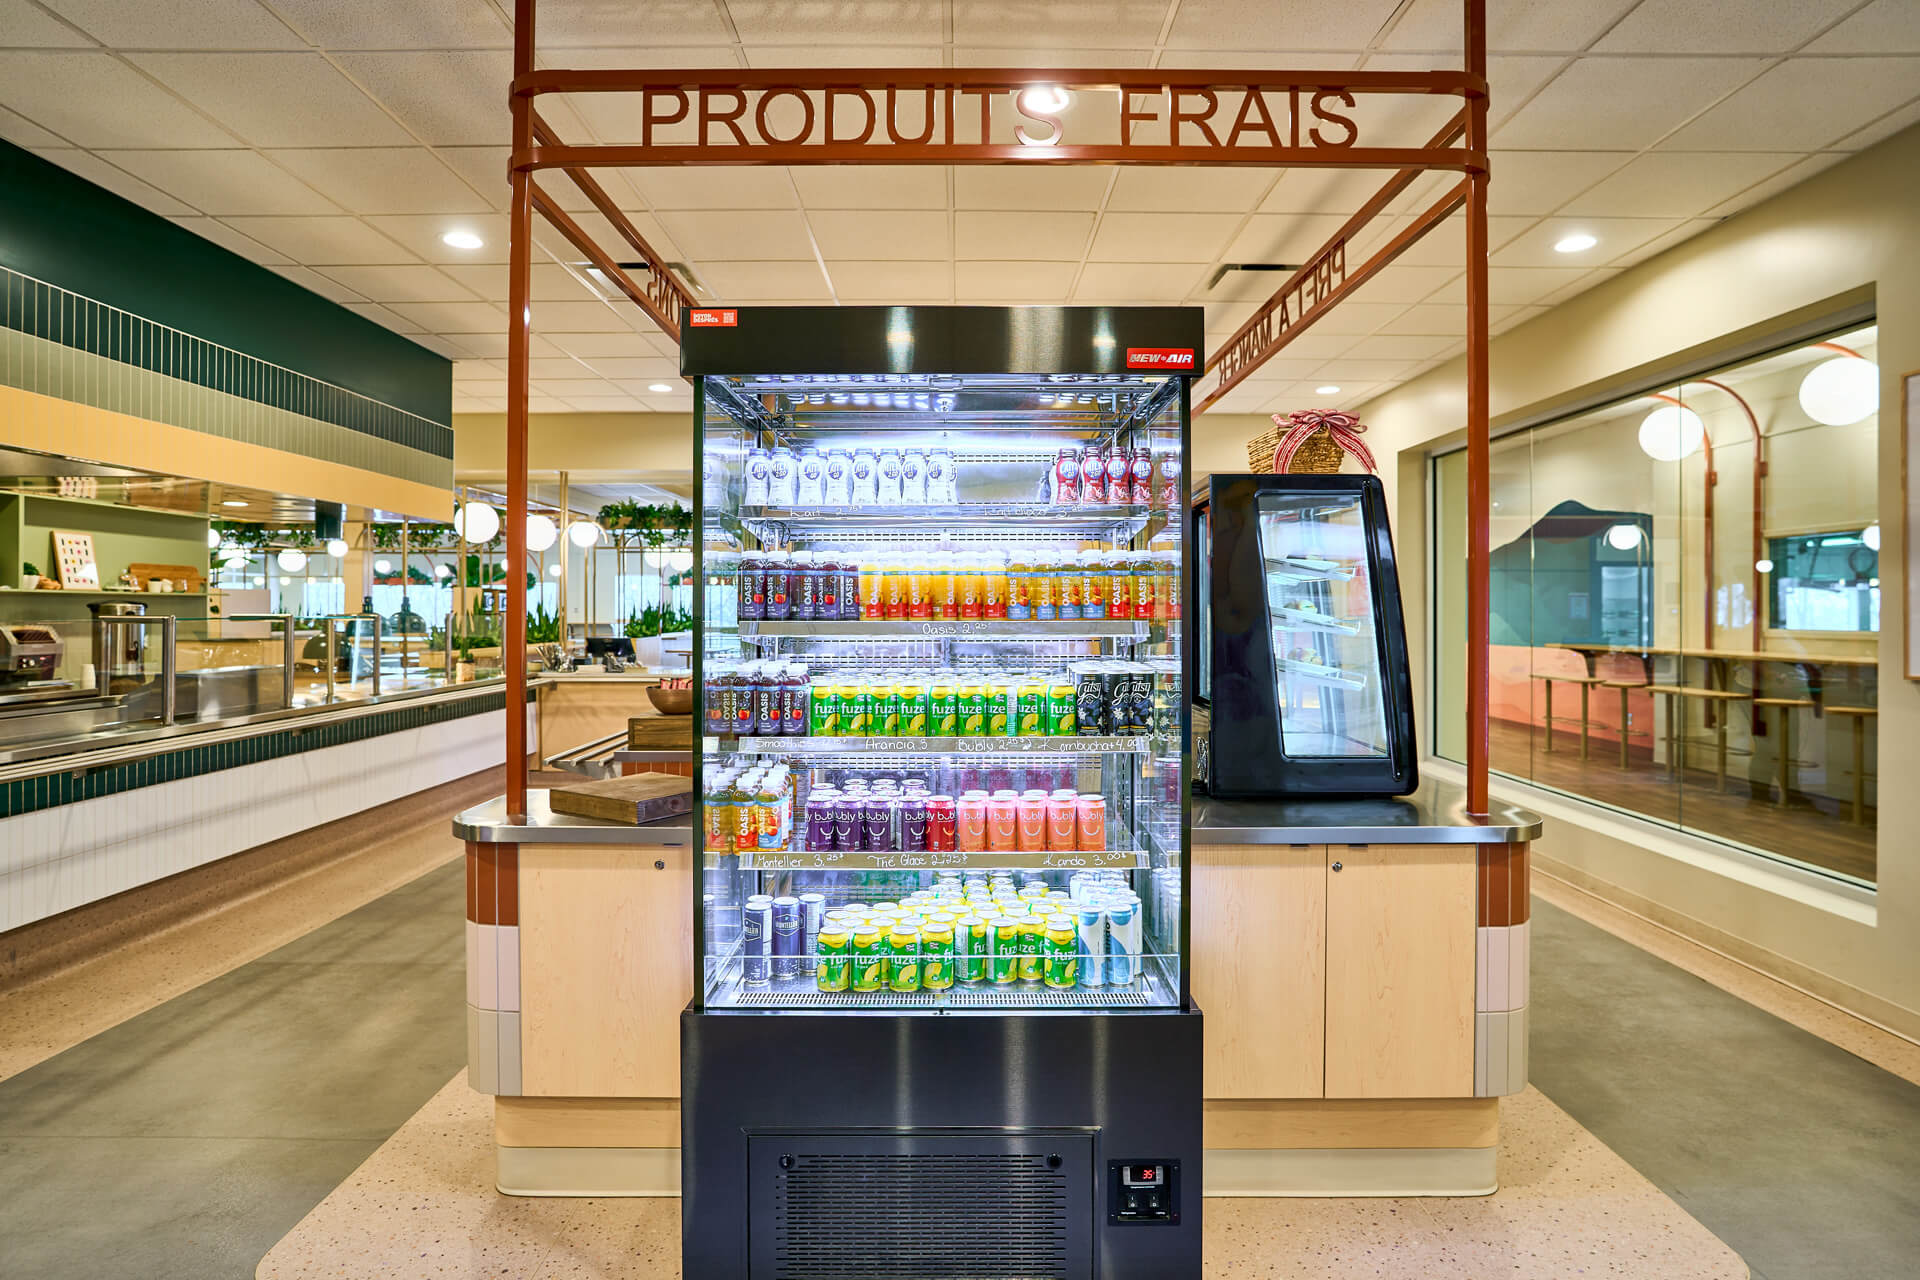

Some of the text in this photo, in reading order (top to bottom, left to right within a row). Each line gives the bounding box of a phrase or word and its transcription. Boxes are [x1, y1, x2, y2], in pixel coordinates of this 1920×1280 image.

[642, 86, 1358, 148] PRODUITS FRAIS
[744, 576, 752, 605] OASIS
[804, 576, 812, 605] OASIS
[846, 578, 854, 605] OASIS
[1062, 578, 1070, 606] OASIS
[1113, 577, 1121, 605] OASIS
[1139, 577, 1147, 605] OASIS
[922, 622, 956, 635] Oasis
[841, 703, 865, 714] fuze
[901, 703, 925, 714] fuze
[932, 703, 955, 714] fuze
[958, 703, 982, 714] fuze
[1050, 702, 1075, 714] fuze
[866, 738, 915, 750] Arancia
[959, 739, 993, 752] Bubly
[740, 809, 748, 836] OASIS
[866, 811, 890, 821] bubly
[1079, 811, 1104, 822] bubly
